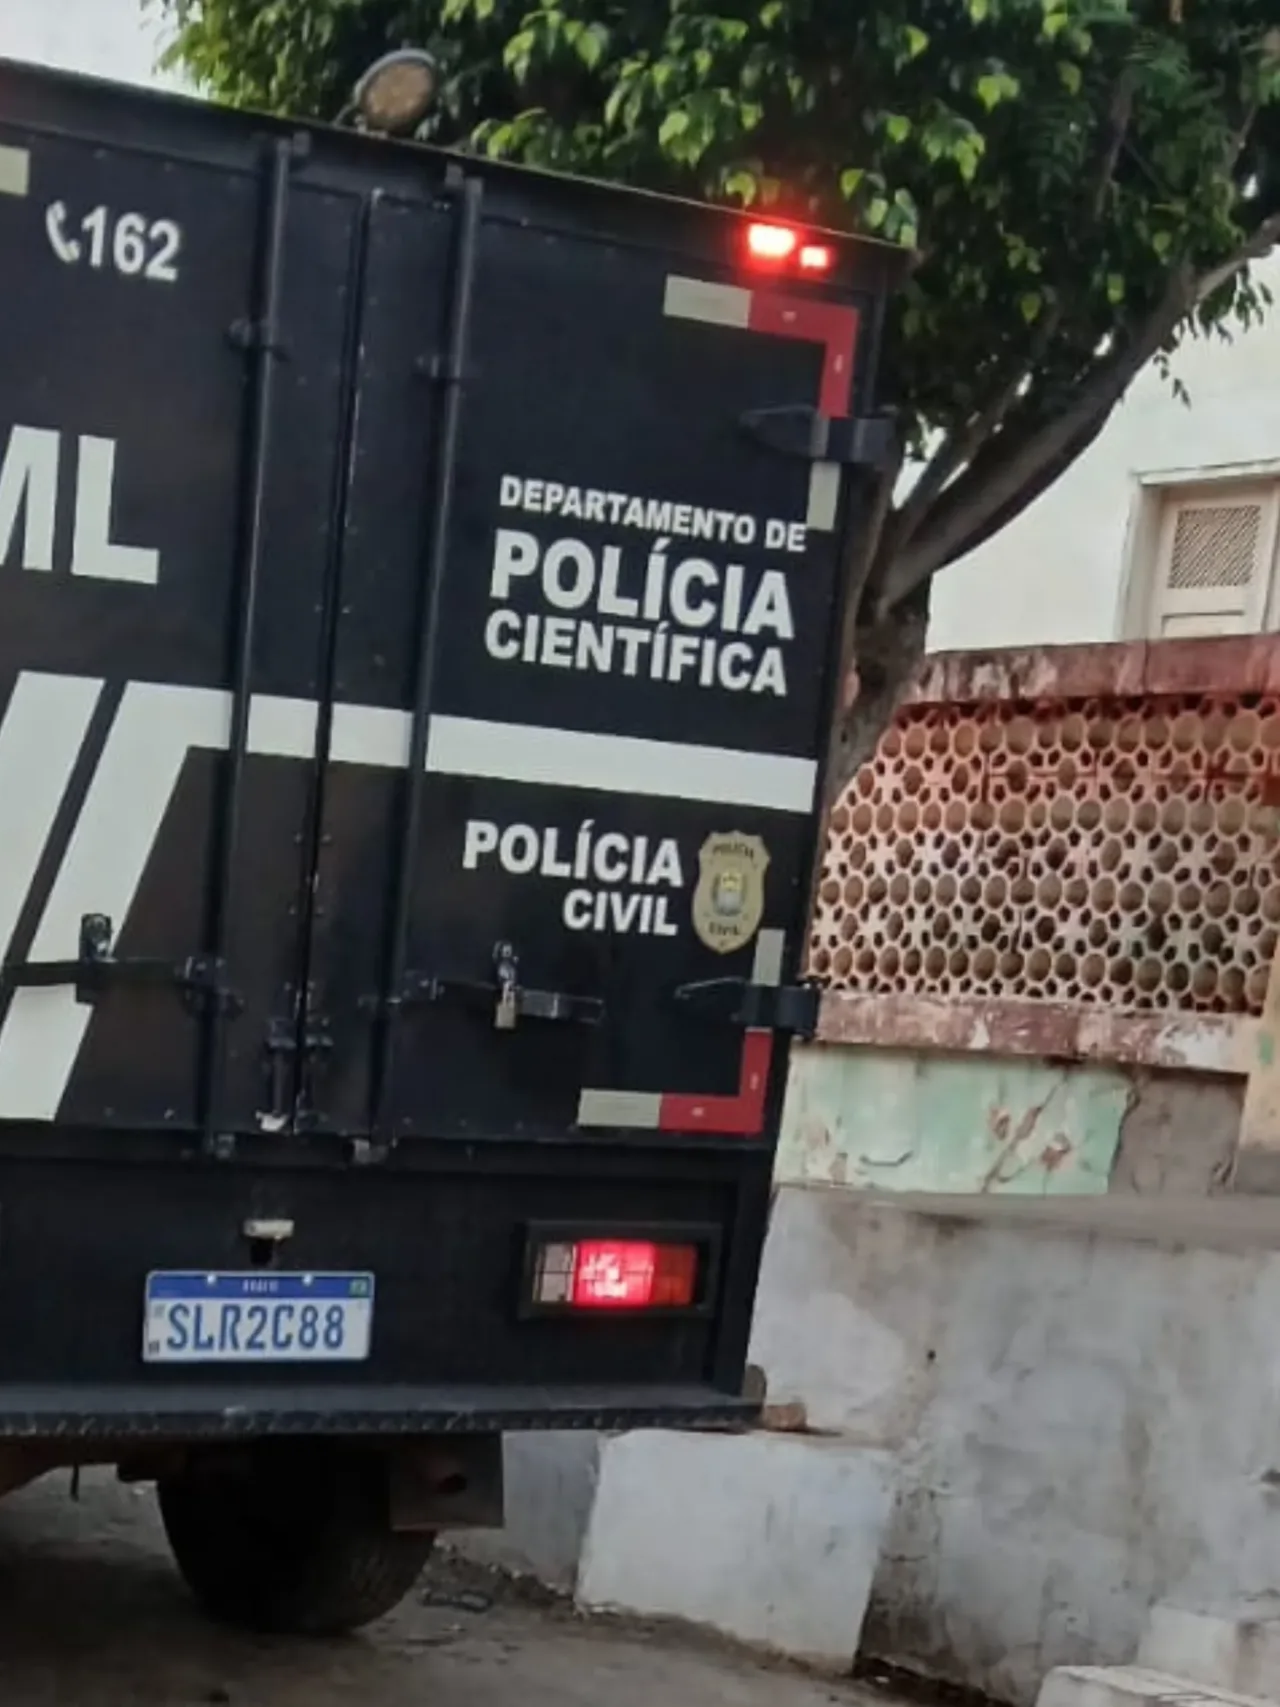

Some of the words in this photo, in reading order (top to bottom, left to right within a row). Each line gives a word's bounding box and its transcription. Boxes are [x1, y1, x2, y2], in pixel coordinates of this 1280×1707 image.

[80, 206, 181, 282] 162
[500, 474, 757, 545] DEPARTAMENTO
[764, 518, 808, 553] DE
[489, 527, 795, 640] POLÍCIA
[483, 607, 788, 697] CIENTÍFICA
[462, 818, 684, 888] POLÍCIA
[562, 888, 679, 937] CIVIL
[166, 1302, 345, 1352] SLR2C88
